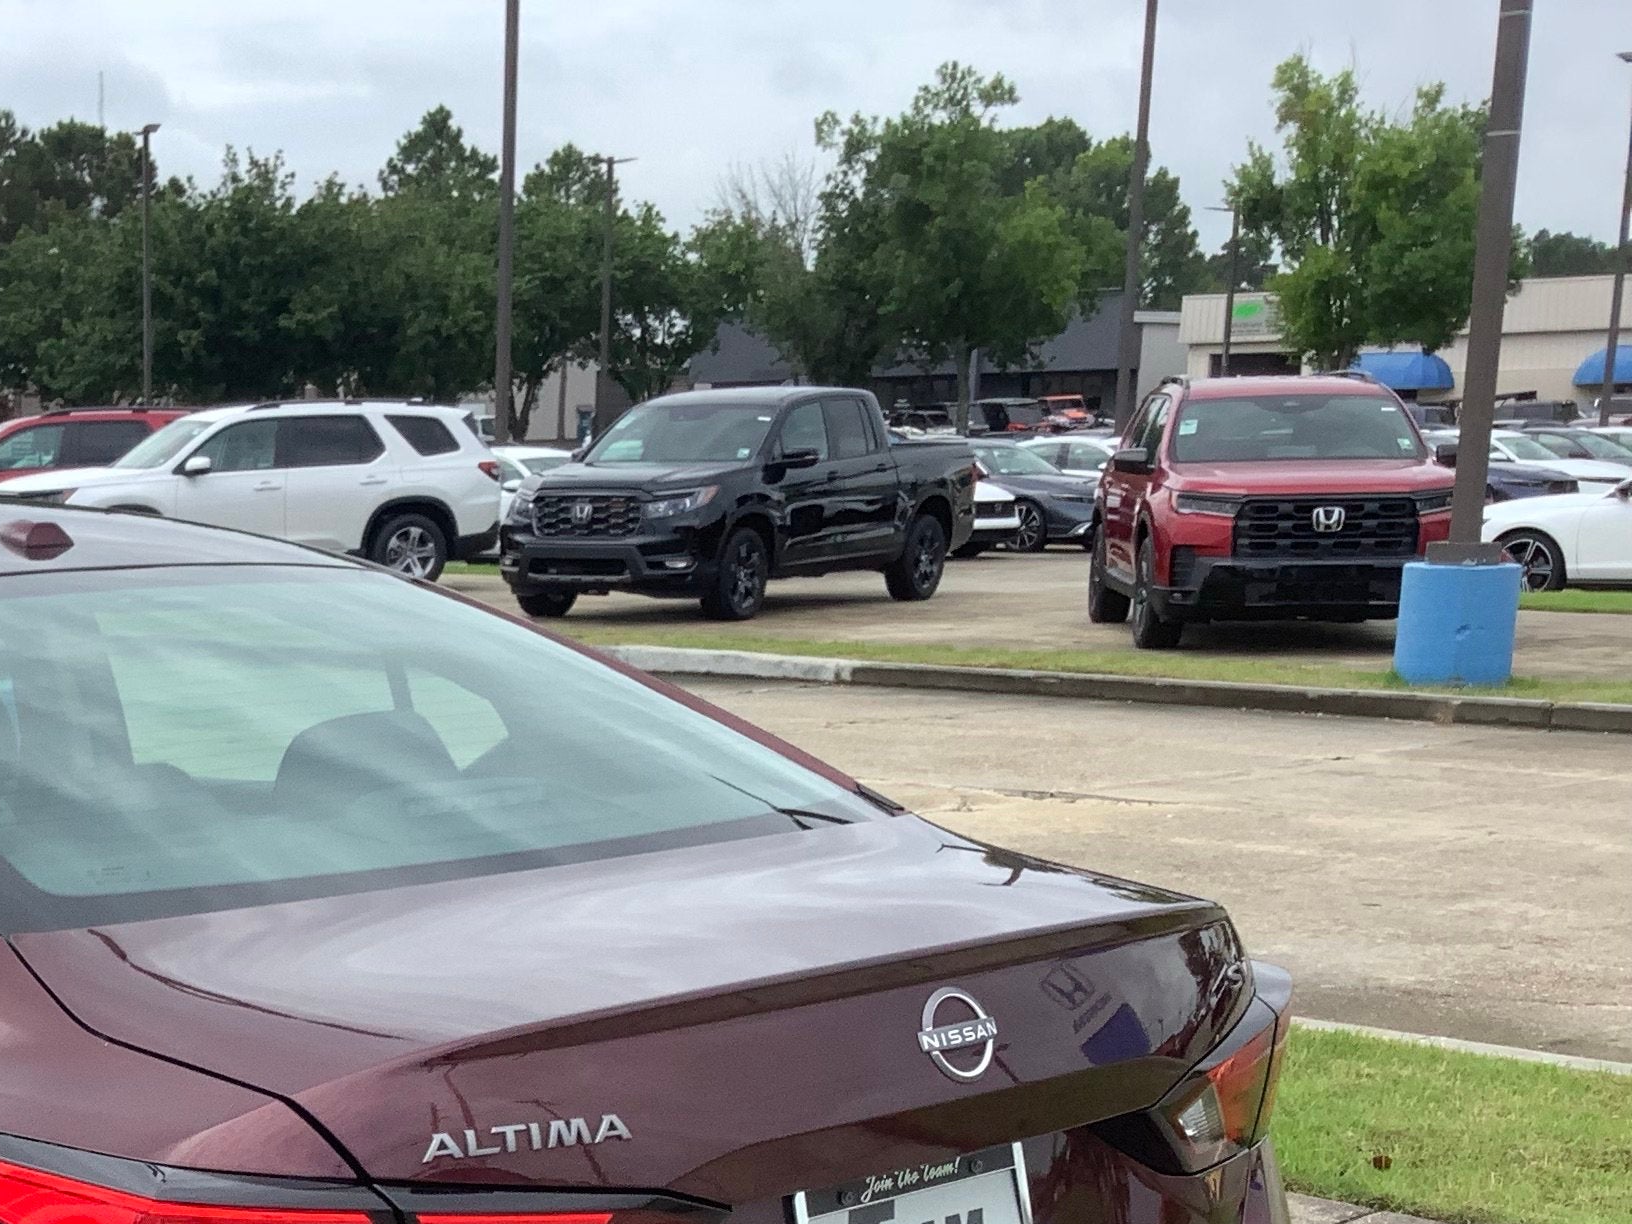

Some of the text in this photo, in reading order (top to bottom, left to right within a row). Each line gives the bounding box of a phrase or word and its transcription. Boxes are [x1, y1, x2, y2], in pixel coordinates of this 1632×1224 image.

[921, 1020, 998, 1050] NISSAN
[422, 1113, 634, 1164] ALTIMA
[860, 1174, 894, 1203] Join
[894, 1168, 919, 1189] the
